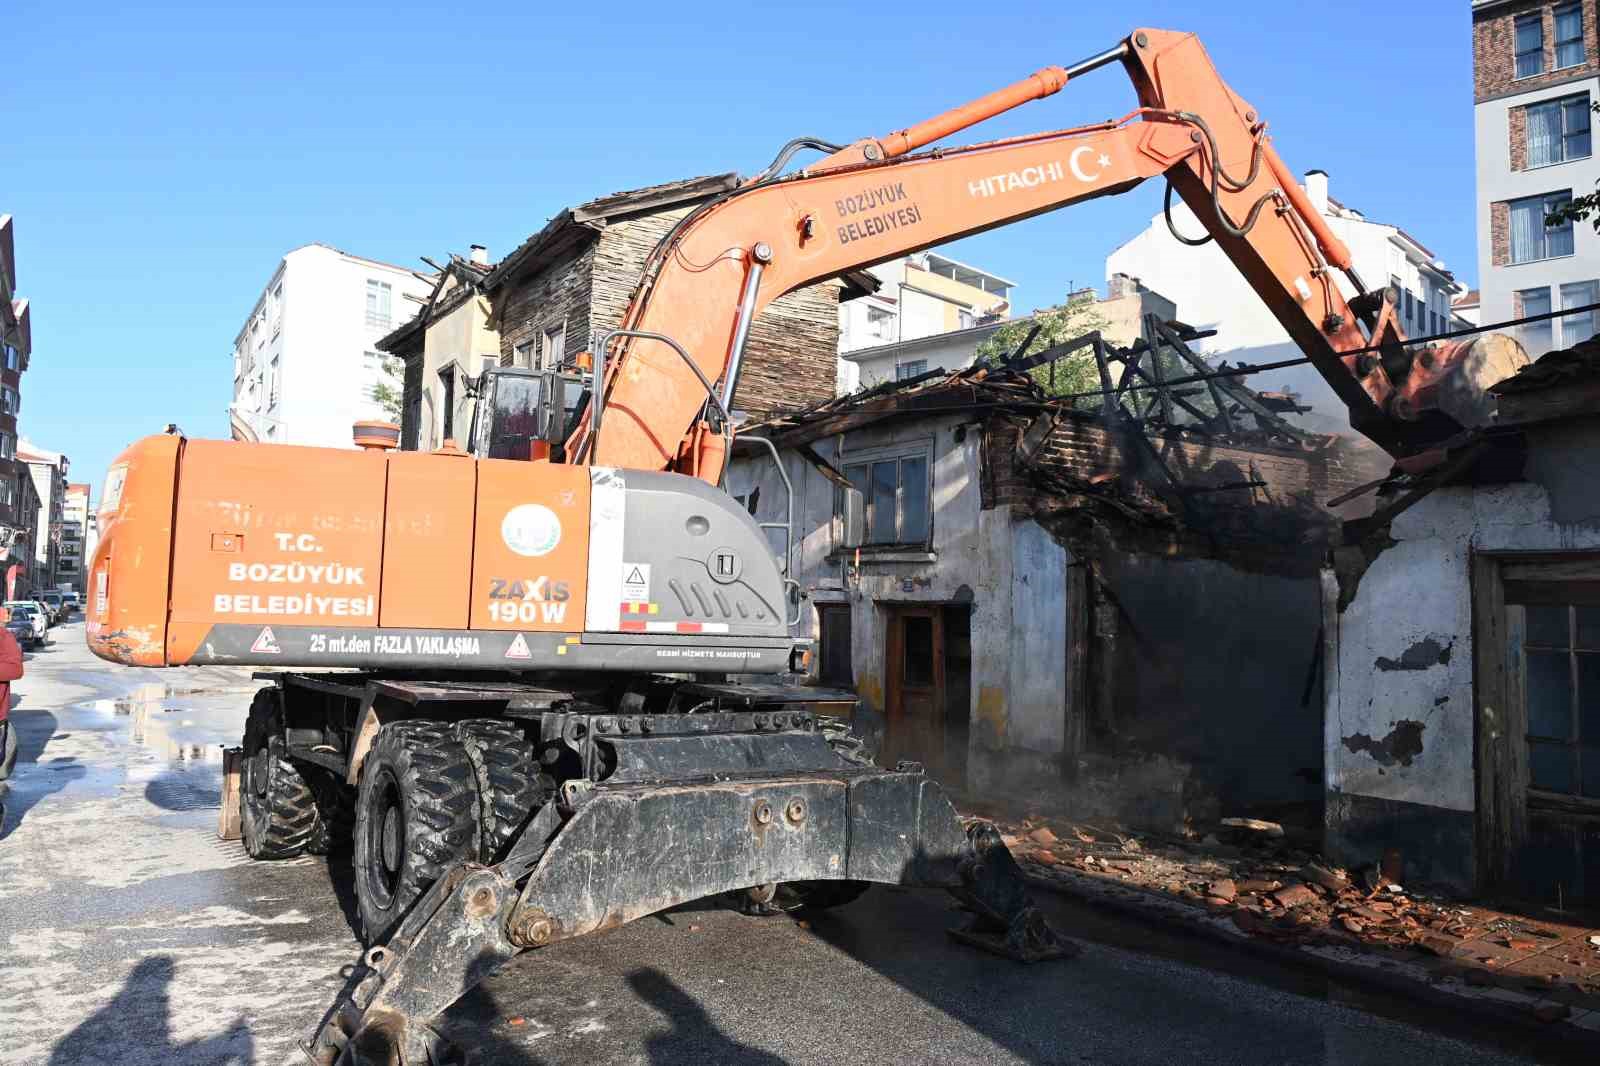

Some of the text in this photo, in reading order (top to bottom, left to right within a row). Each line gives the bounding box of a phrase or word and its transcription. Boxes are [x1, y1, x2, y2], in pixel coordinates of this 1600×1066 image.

[968, 161, 1064, 197] HITACHI
[838, 202, 921, 244] BELEDİYESİ
[274, 532, 323, 552] T.C.
[229, 562, 365, 585] BOZÜYÜK
[489, 576, 570, 601] ZAXIS
[214, 592, 375, 616] BELEDİYESİ
[310, 635, 326, 653] 25
[374, 636, 412, 654] FAZLA
[416, 637, 480, 658] YAKLAŞMA
